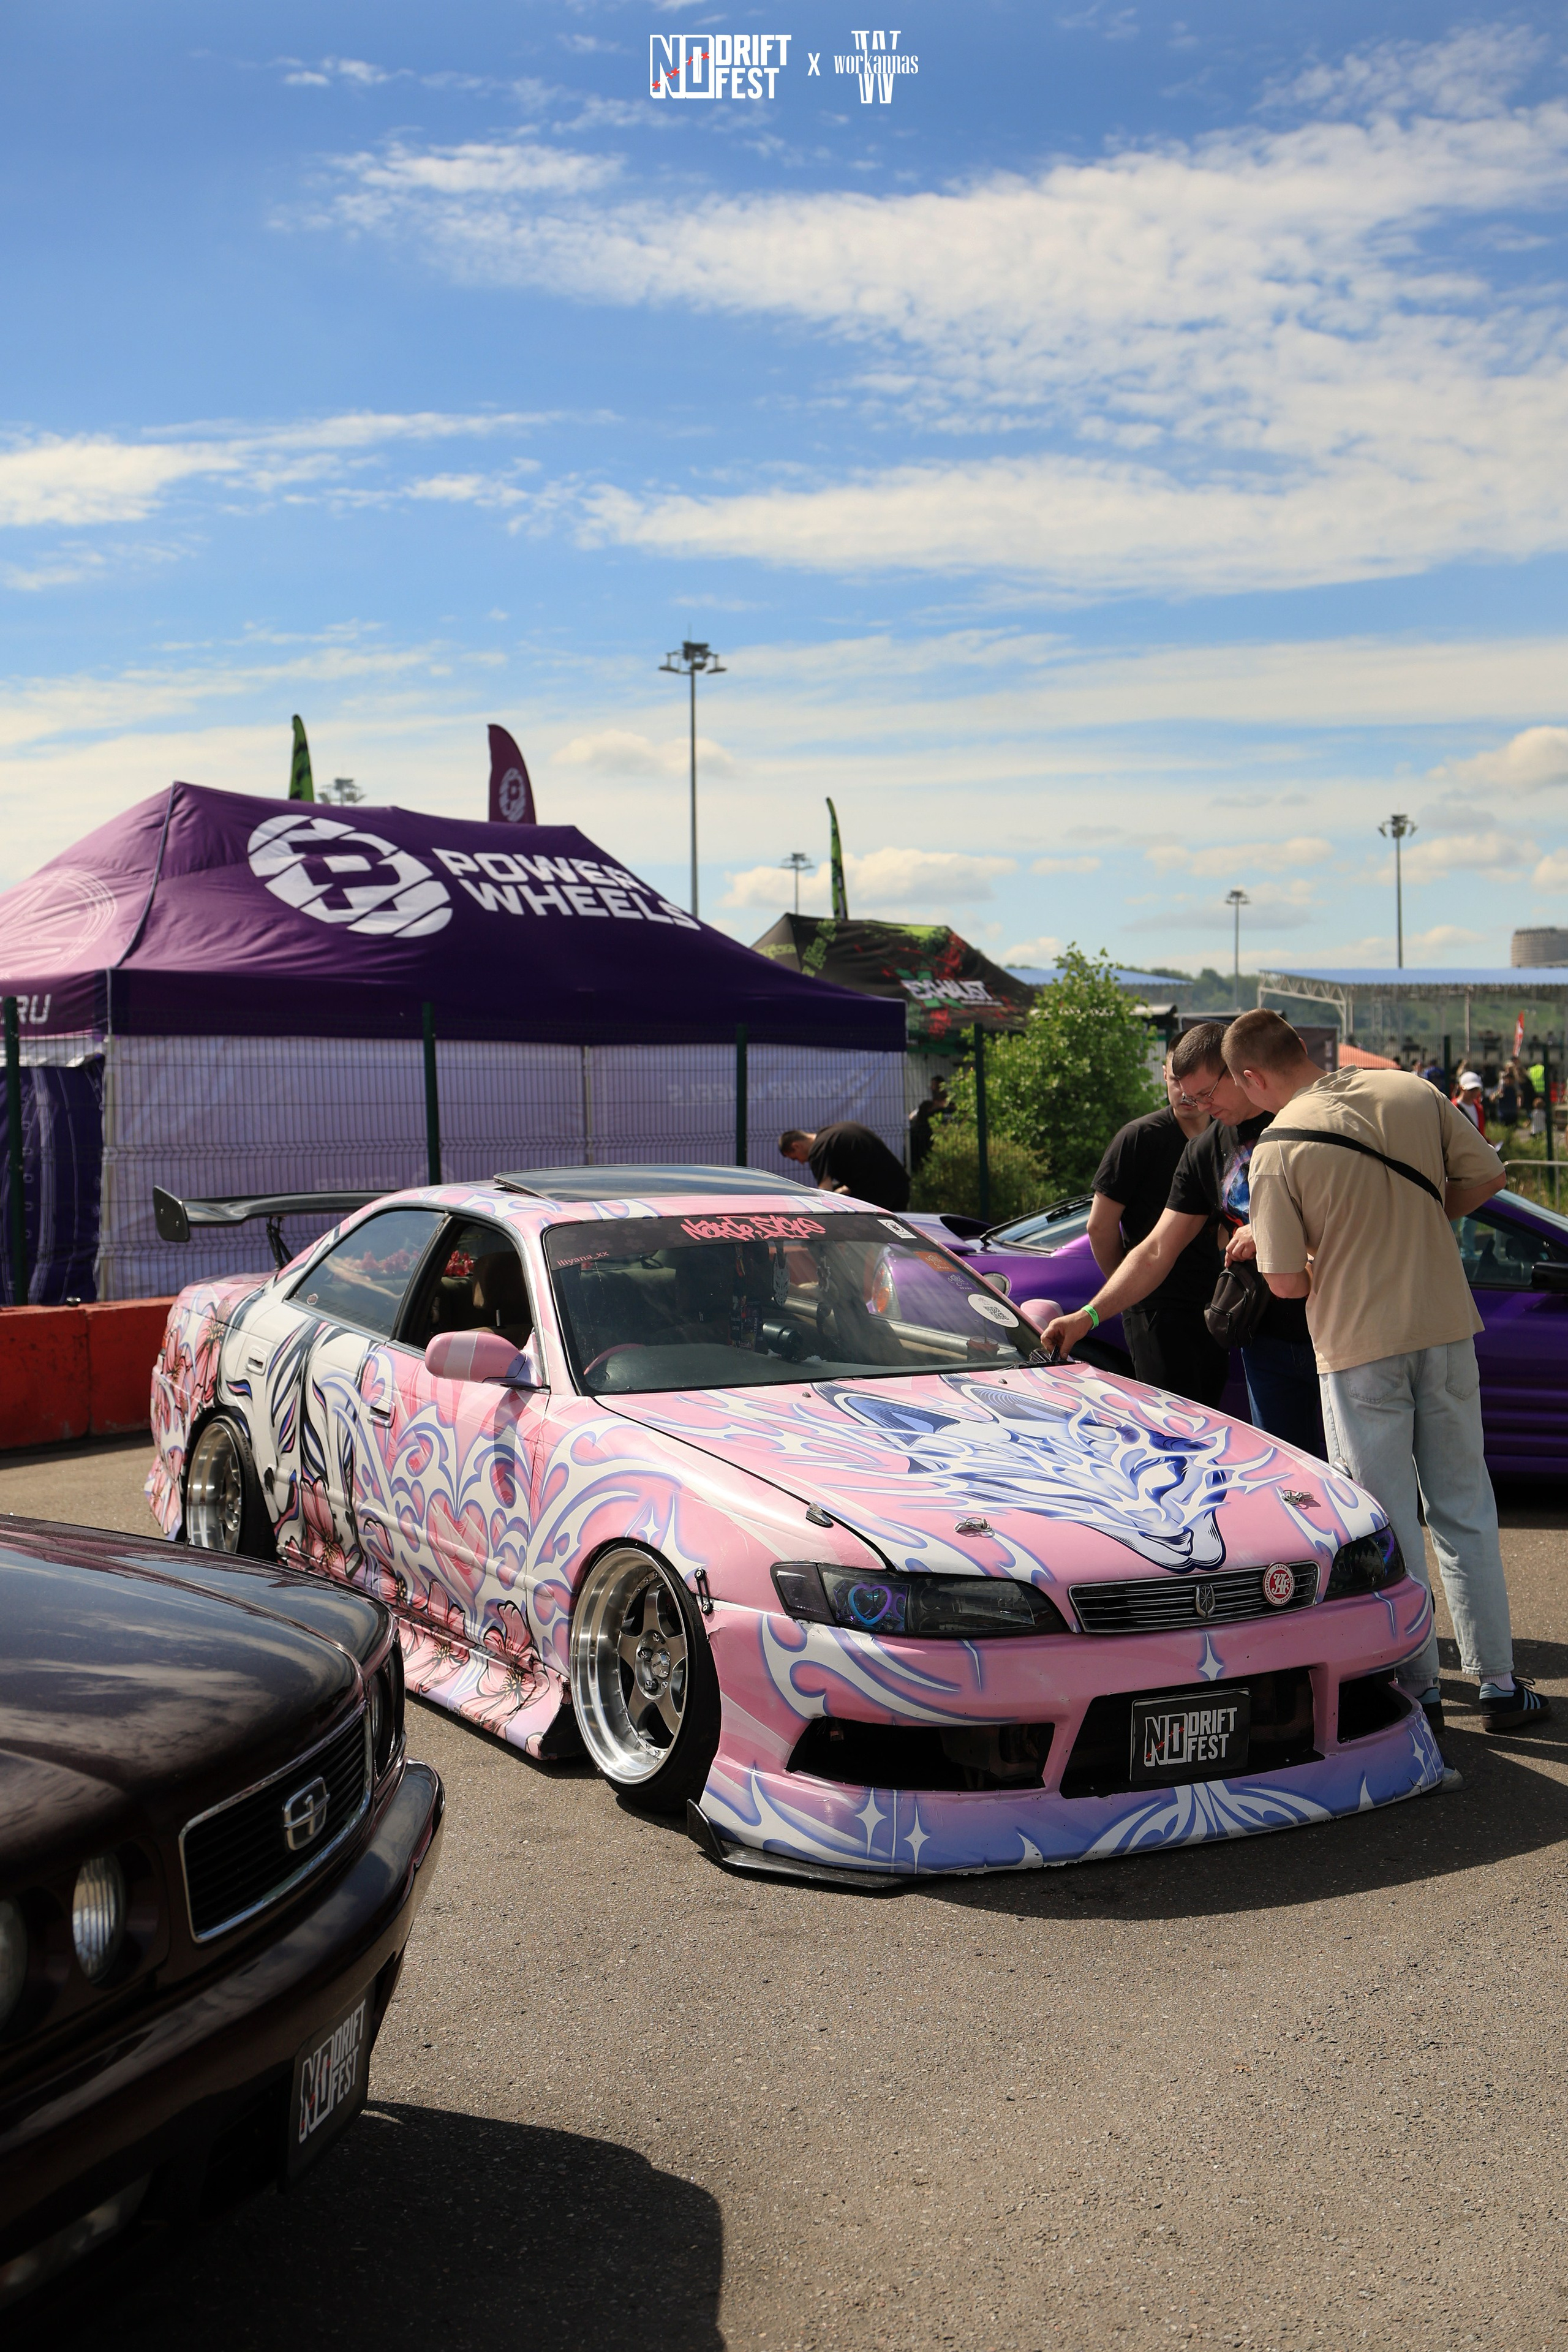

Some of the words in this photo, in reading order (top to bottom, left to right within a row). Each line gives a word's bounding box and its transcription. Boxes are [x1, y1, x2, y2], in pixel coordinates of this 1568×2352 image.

[431, 848, 651, 897] POWER
[458, 878, 702, 931] WHEELS
[1265, 1572, 1276, 1602] FEDERATION
[1188, 1706, 1238, 1737] DRIFT
[1187, 1733, 1230, 1763] FEST
[332, 1998, 366, 2071] DRIFT
[329, 2044, 360, 2113] FEST
